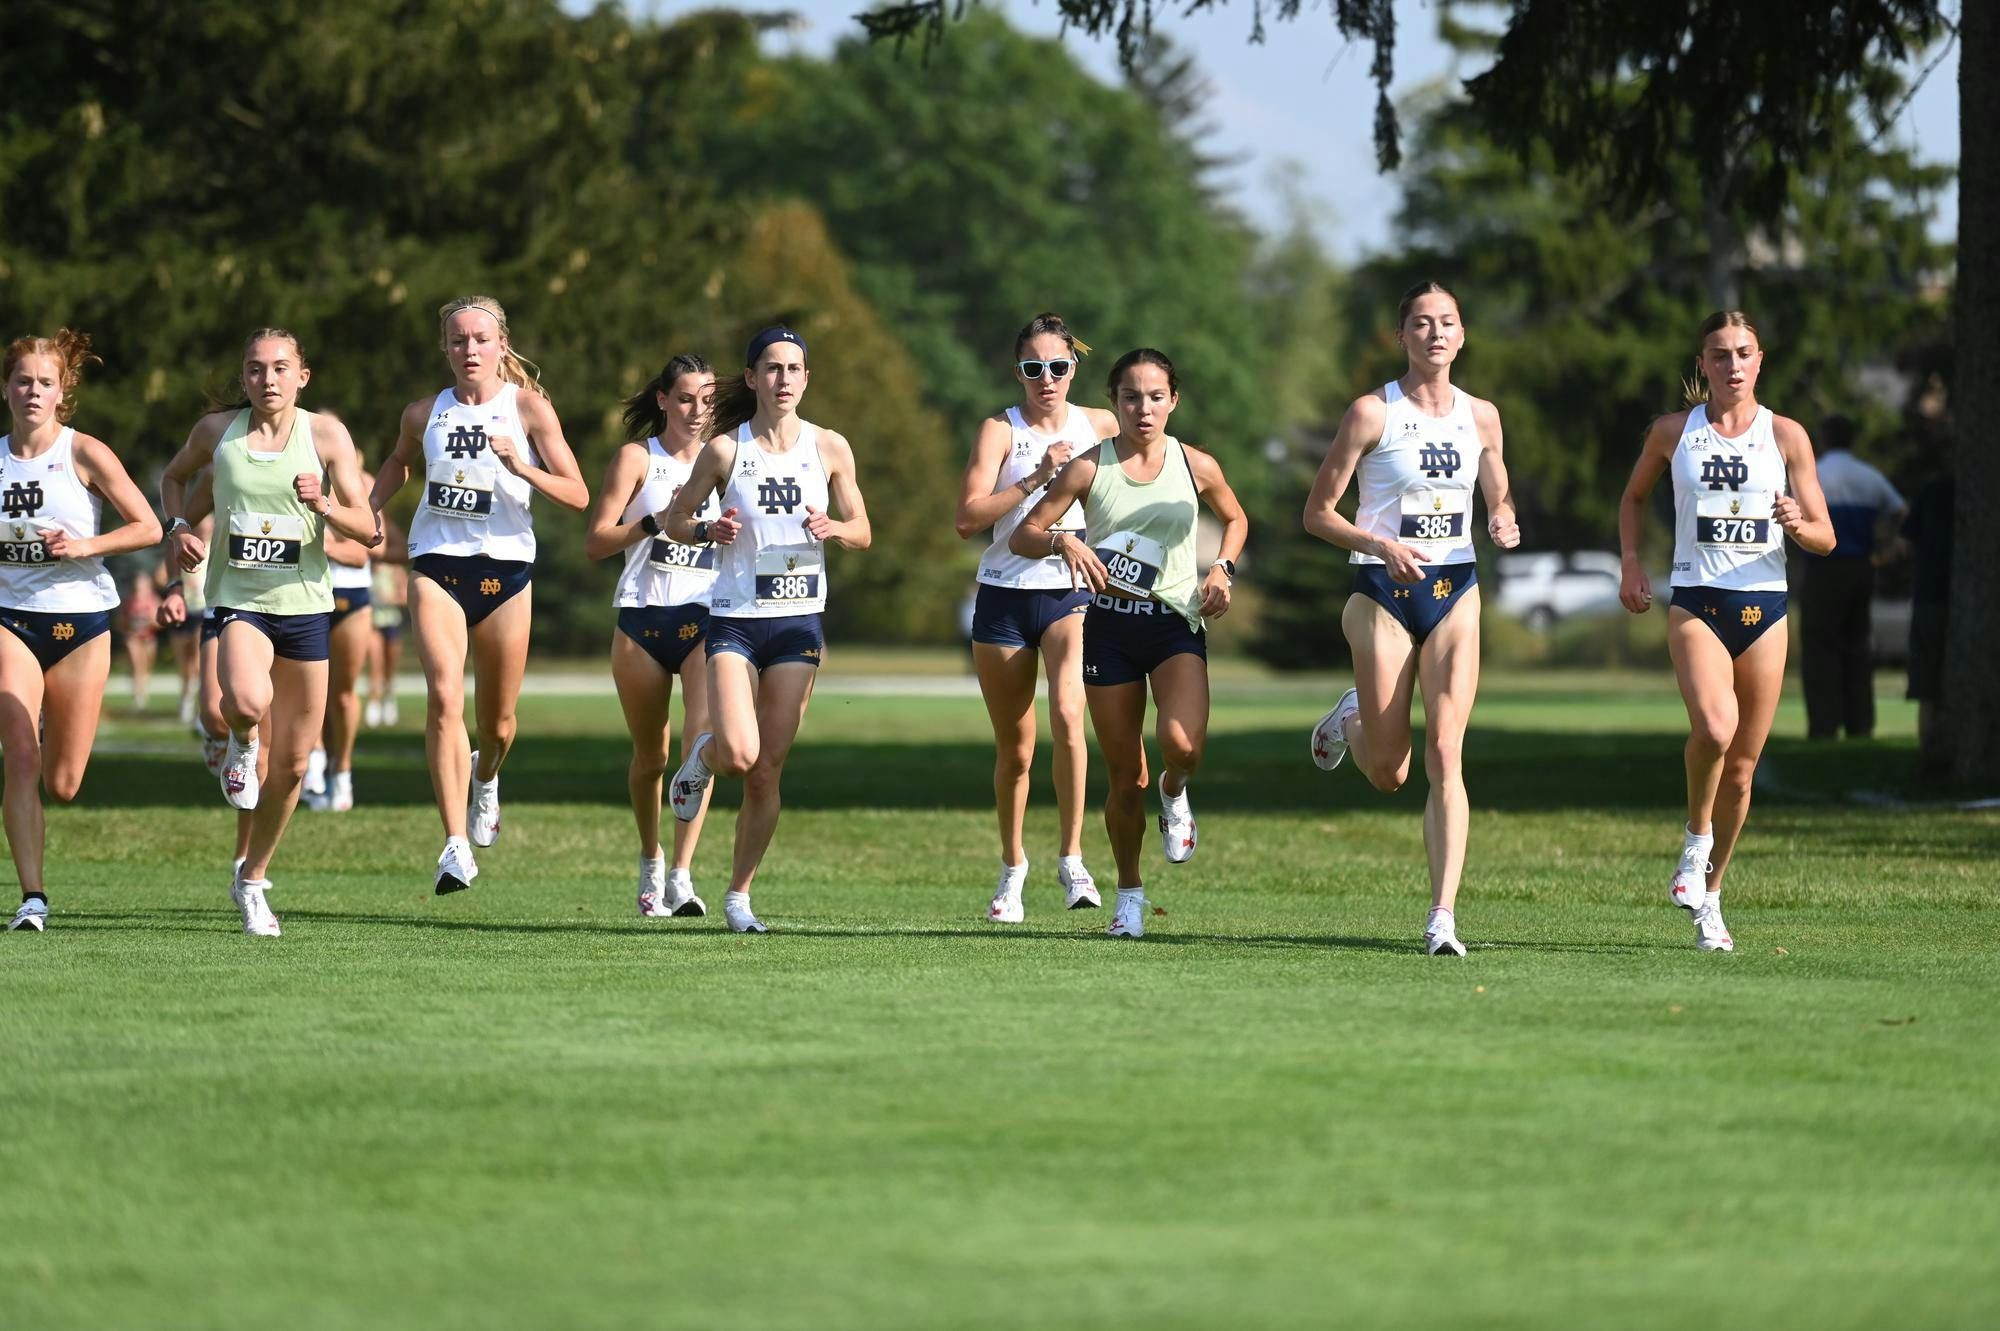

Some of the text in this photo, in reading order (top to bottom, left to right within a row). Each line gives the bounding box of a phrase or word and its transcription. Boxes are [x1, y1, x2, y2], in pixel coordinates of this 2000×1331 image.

[445, 425, 487, 460] ND
[1419, 442, 1461, 478] ND
[738, 469, 759, 478] ACC
[1700, 454, 1748, 491] ND
[2, 480, 44, 519] ND
[438, 486, 478, 512] 379
[758, 477, 802, 514] ND
[1415, 515, 1452, 539] 385
[1712, 518, 1755, 543] 376
[4, 542, 45, 562] 378
[242, 538, 286, 562] 502
[665, 543, 703, 567] 387
[1107, 554, 1142, 584] 499
[480, 578, 501, 595] ND
[772, 576, 808, 599] 386
[1741, 606, 1762, 626] ND
[53, 622, 75, 640] ND
